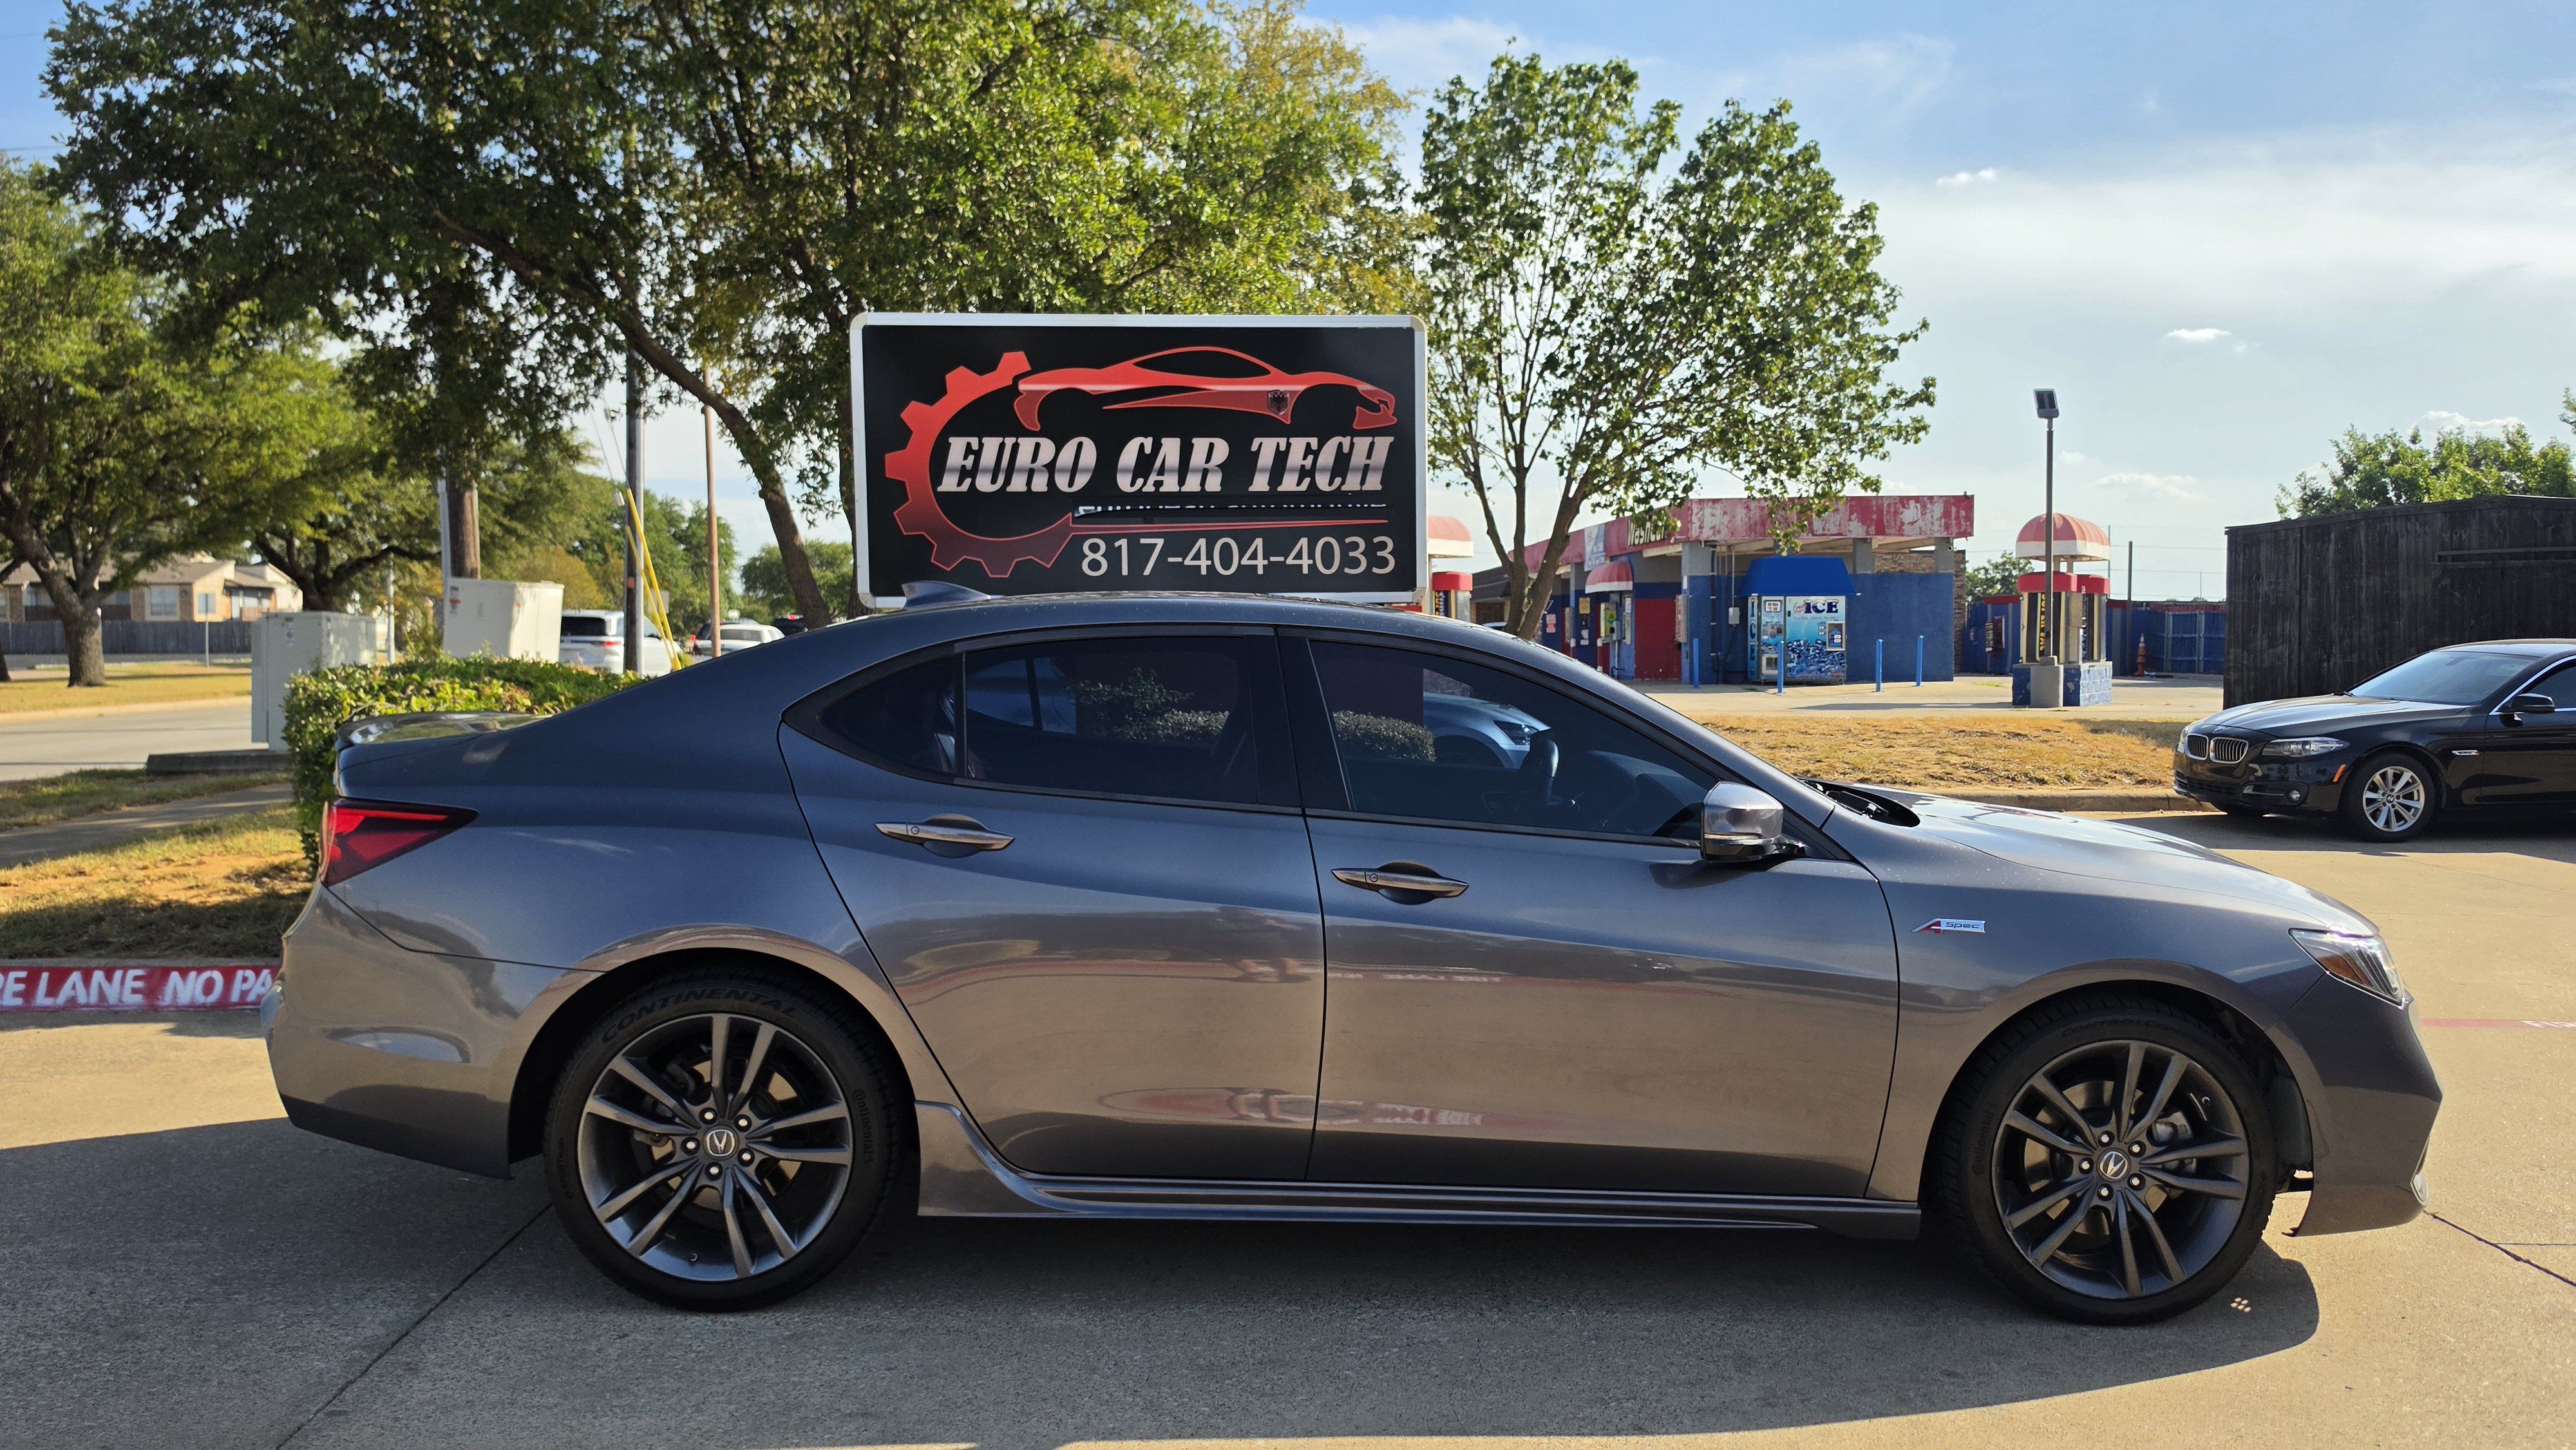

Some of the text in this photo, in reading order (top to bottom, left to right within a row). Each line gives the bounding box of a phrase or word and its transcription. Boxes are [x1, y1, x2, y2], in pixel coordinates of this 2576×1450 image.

[938, 436, 1395, 493] EURO CAR TECH
[1081, 536, 1396, 577] 817-404-4033
[1803, 599, 1839, 614] ICE
[33, 968, 148, 1006] LANE
[158, 970, 223, 1005] NO
[602, 988, 797, 1044] CONTINENTAL
[2521, 1020, 2576, 1028] FIR
[852, 1088, 875, 1154] Continental
